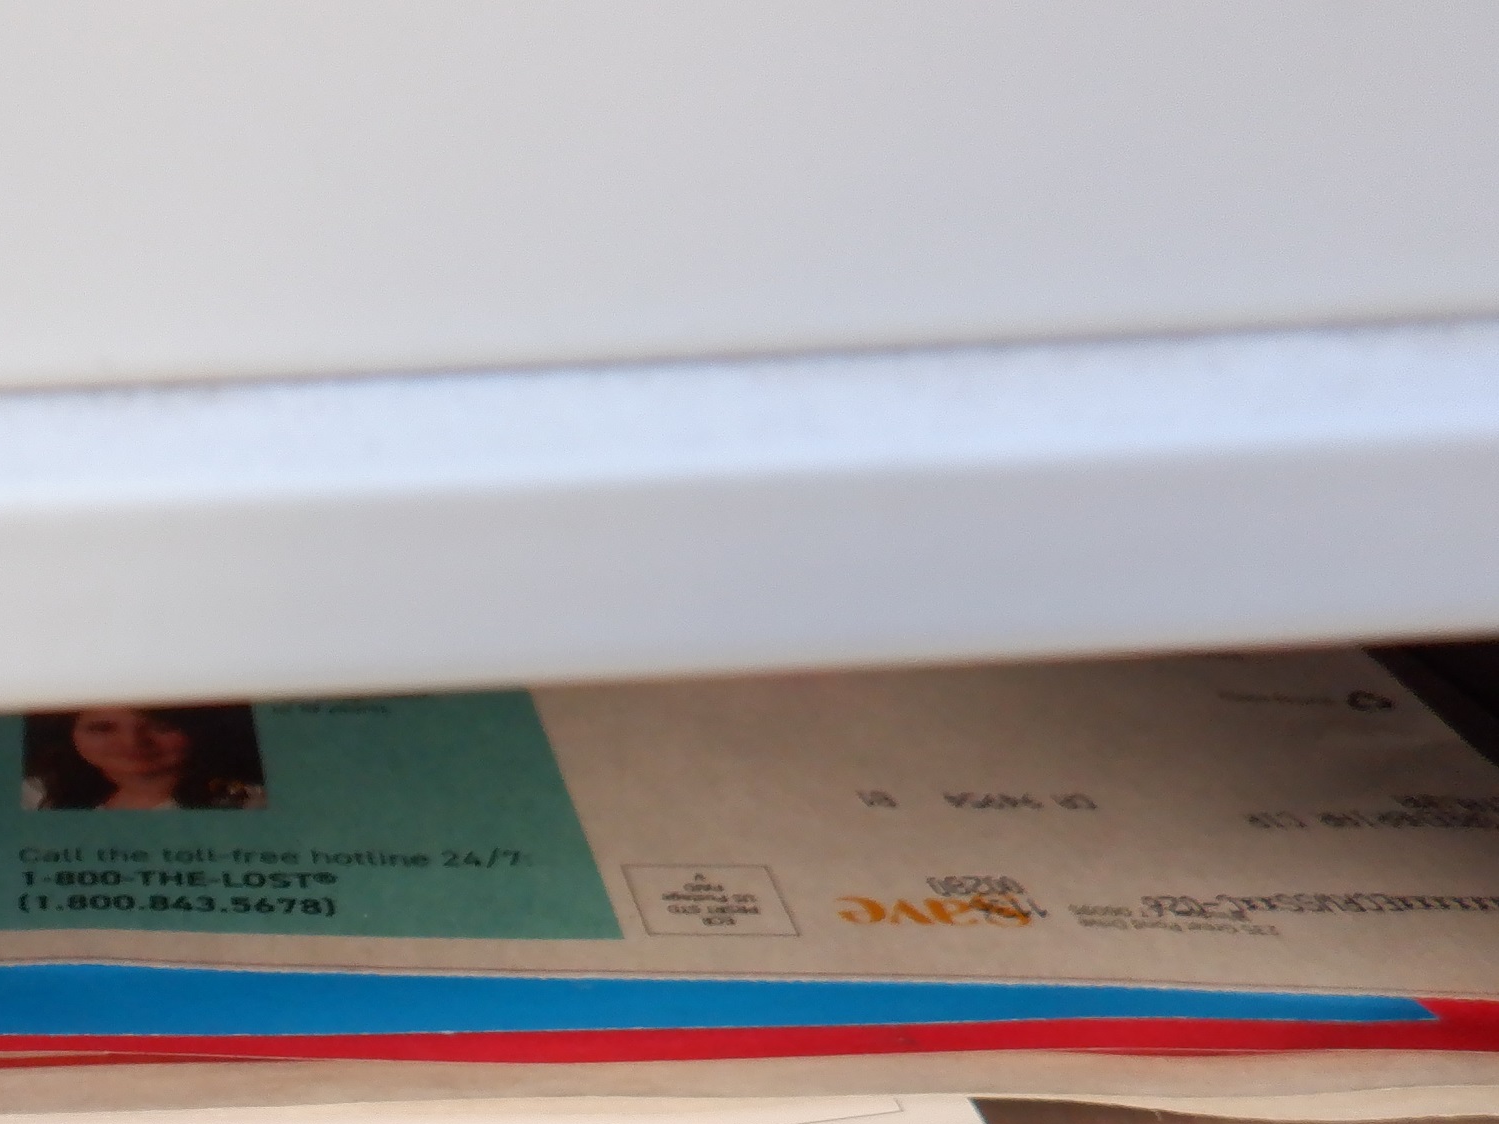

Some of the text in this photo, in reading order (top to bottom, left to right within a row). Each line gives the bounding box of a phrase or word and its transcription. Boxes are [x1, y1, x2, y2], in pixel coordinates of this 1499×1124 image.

[18, 846, 83, 864] Call
[96, 846, 149, 864] the
[162, 846, 299, 865] toll-free
[310, 847, 430, 868] hotline
